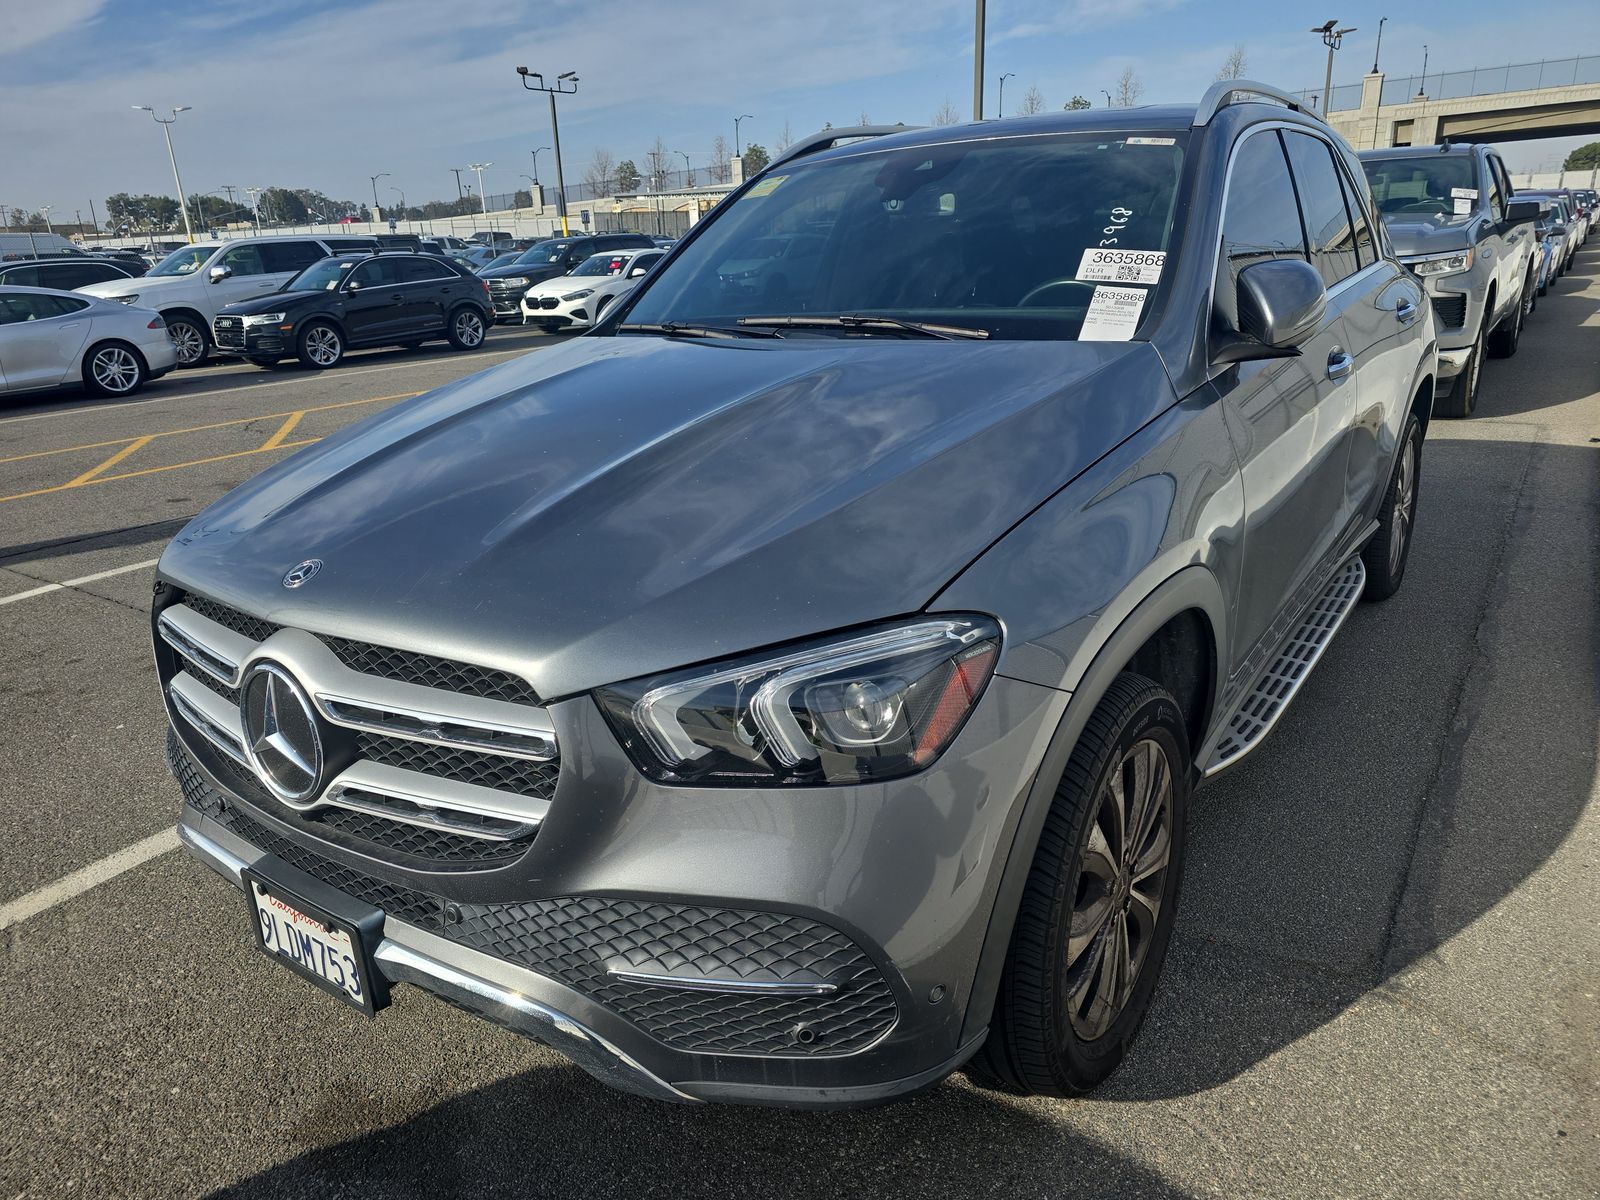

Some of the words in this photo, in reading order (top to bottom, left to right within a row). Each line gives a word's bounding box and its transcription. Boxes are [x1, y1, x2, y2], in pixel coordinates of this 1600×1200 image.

[1092, 251, 1166, 267] 3635868
[1093, 290, 1146, 304] 3635868
[260, 908, 362, 996] 9LDM753
